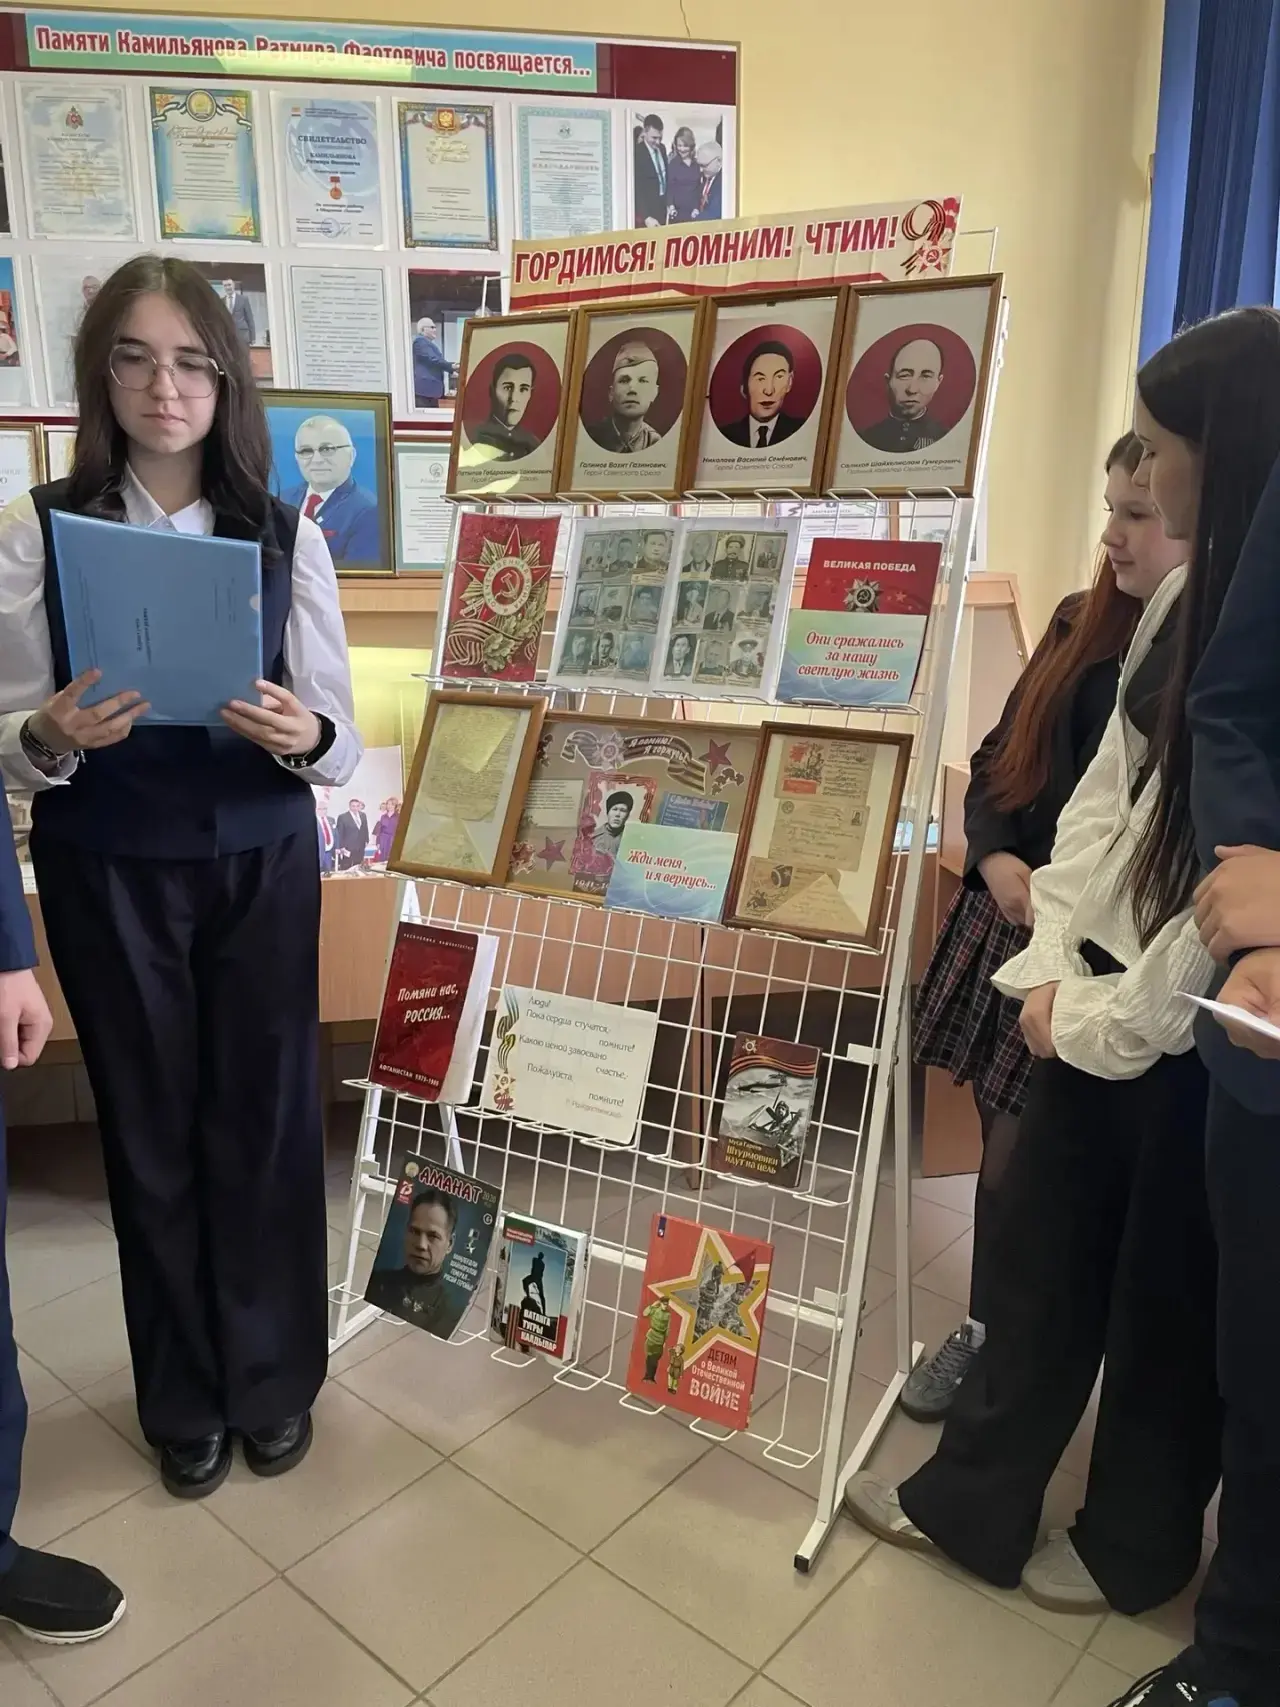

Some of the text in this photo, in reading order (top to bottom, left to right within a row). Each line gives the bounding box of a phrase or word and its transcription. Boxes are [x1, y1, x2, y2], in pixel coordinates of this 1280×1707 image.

[36, 27, 109, 52] Памяти
[117, 31, 247, 57] Камильянова
[256, 37, 336, 64] Ратмира
[455, 51, 590, 76] посвящается...
[298, 135, 367, 144] СВИДЕТЕЛЬСТВО
[515, 215, 899, 285] ГОРДИМСЯ! ПОМНИМ! ЧТИМ!
[823, 560, 916, 572] ВЕЛИКАЯ ПОБЕДА
[806, 632, 904, 650] Они сражались
[825, 652, 878, 666] за нашу
[798, 665, 899, 681] светлую жизнь
[629, 737, 674, 748] Я помню!
[644, 745, 652, 755] Я
[627, 850, 652, 865] Жди
[645, 870, 717, 889] и я вернусь...
[398, 984, 459, 1002] Помяни нас,
[528, 996, 551, 1009] Люди!
[404, 1006, 450, 1024] РОССИЯ...
[526, 1008, 545, 1020] Пока
[546, 1014, 572, 1026] сердца
[519, 1034, 607, 1060] Какою ценой завоевано
[599, 1039, 636, 1053] помните!
[379, 1063, 413, 1078] АФГАНИСТАН
[588, 1092, 625, 1107] помните!
[725, 1155, 777, 1174] идут на цель
[727, 1145, 778, 1166] Штурмовики
[418, 1166, 483, 1205] АМАНАТ
[708, 1348, 737, 1368] ДЕТЯМ
[691, 1364, 745, 1391] Отечественной
[707, 1360, 738, 1379] Великой
[690, 1377, 740, 1411] ВОЙНЕ
